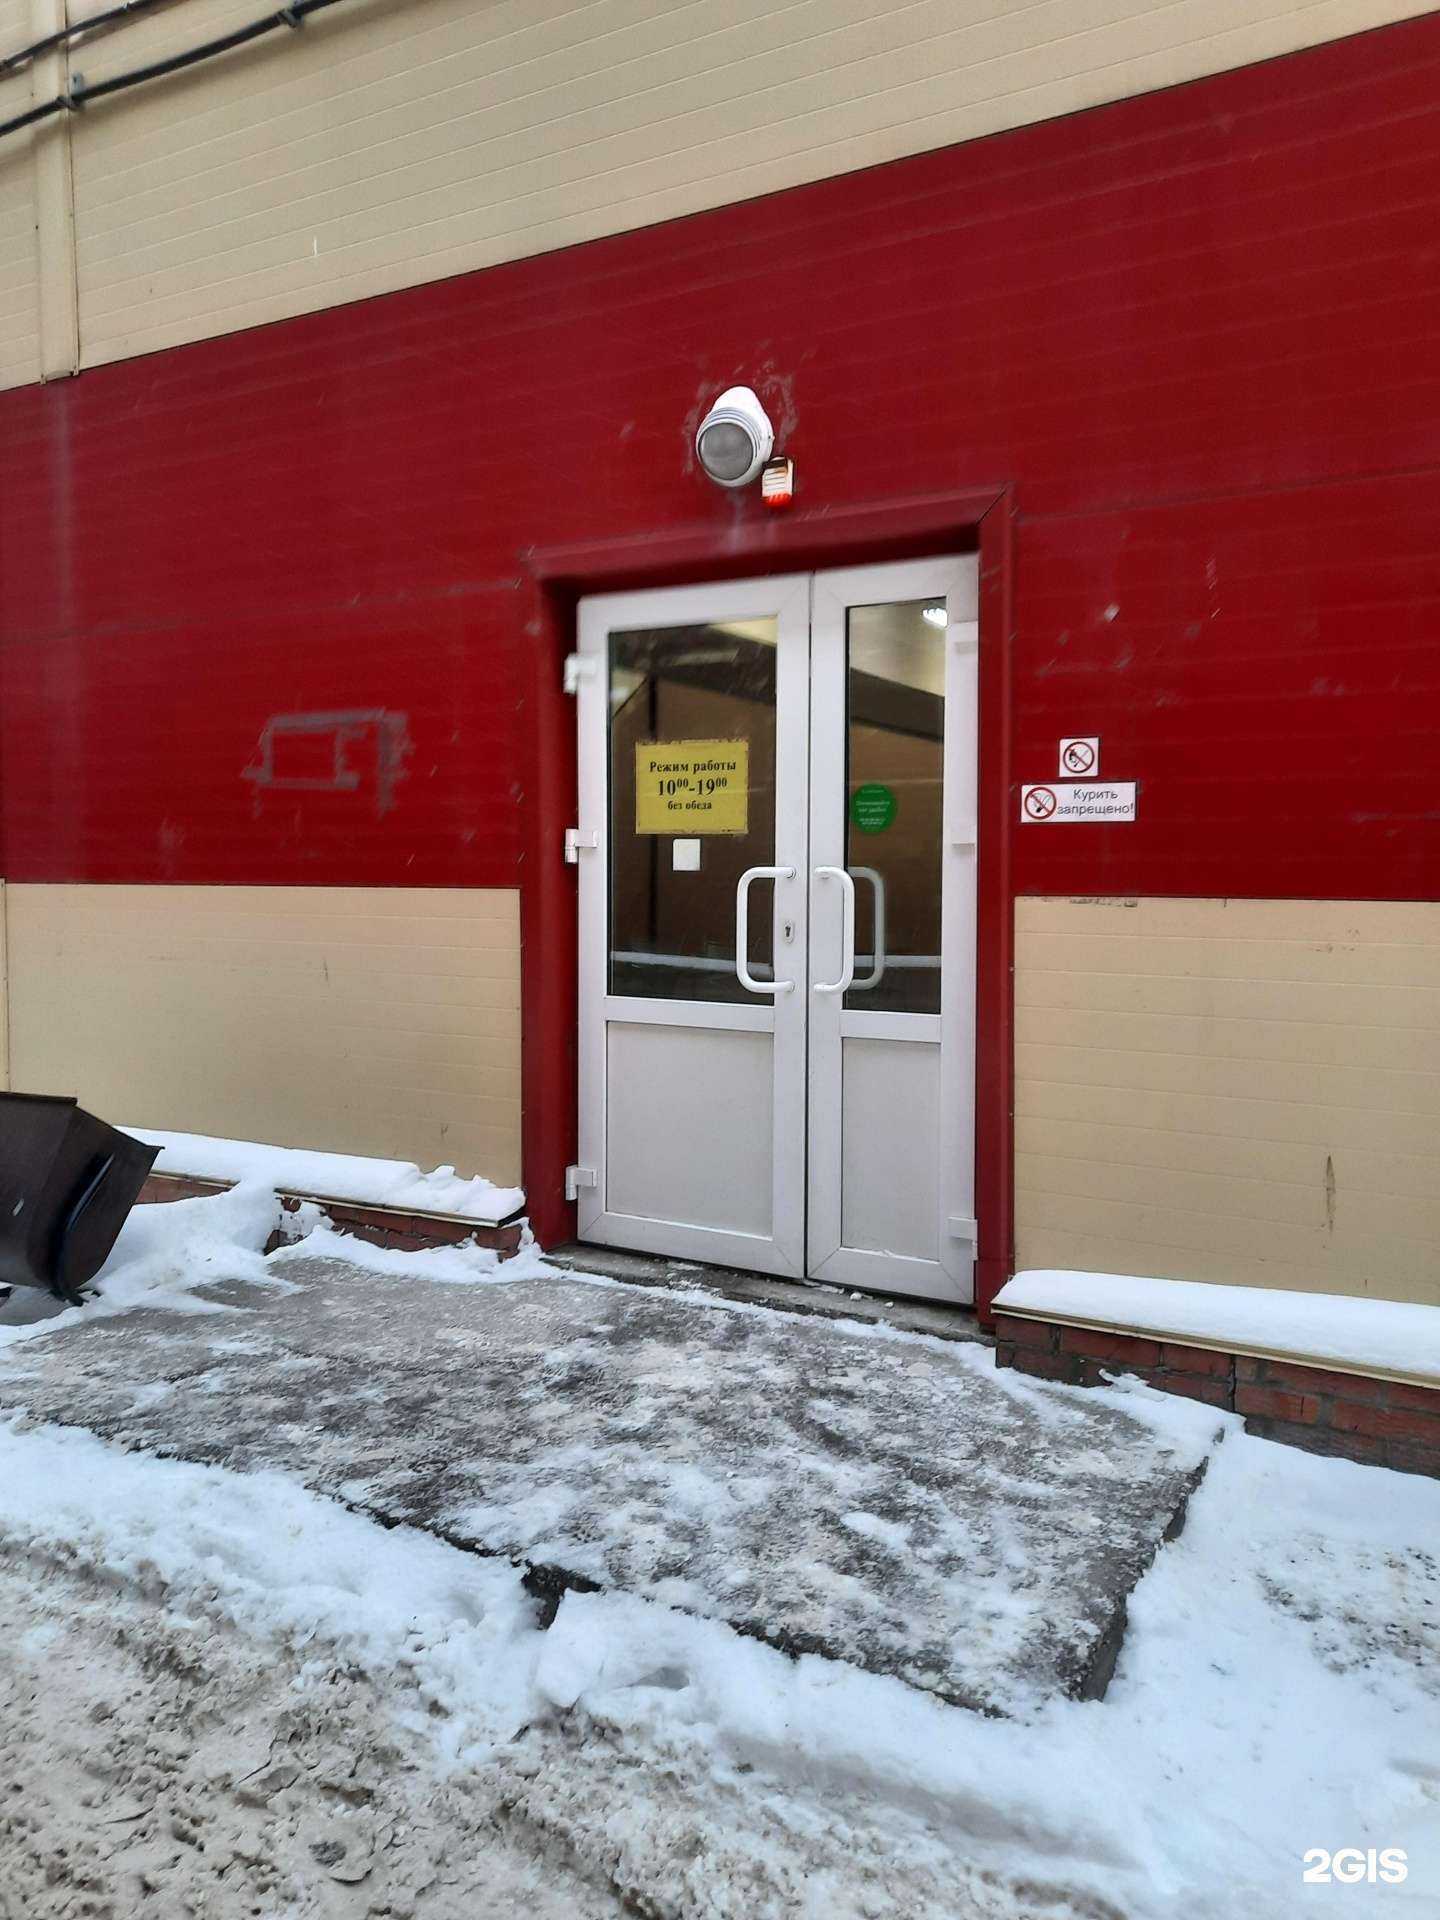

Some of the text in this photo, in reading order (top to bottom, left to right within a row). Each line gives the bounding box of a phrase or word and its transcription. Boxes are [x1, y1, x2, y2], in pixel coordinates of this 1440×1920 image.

[650, 760, 736, 774] Режим работы
[1073, 789, 1118, 802] Курить
[667, 800, 712, 810] без обеда
[1057, 802, 1134, 816] запрещено!
